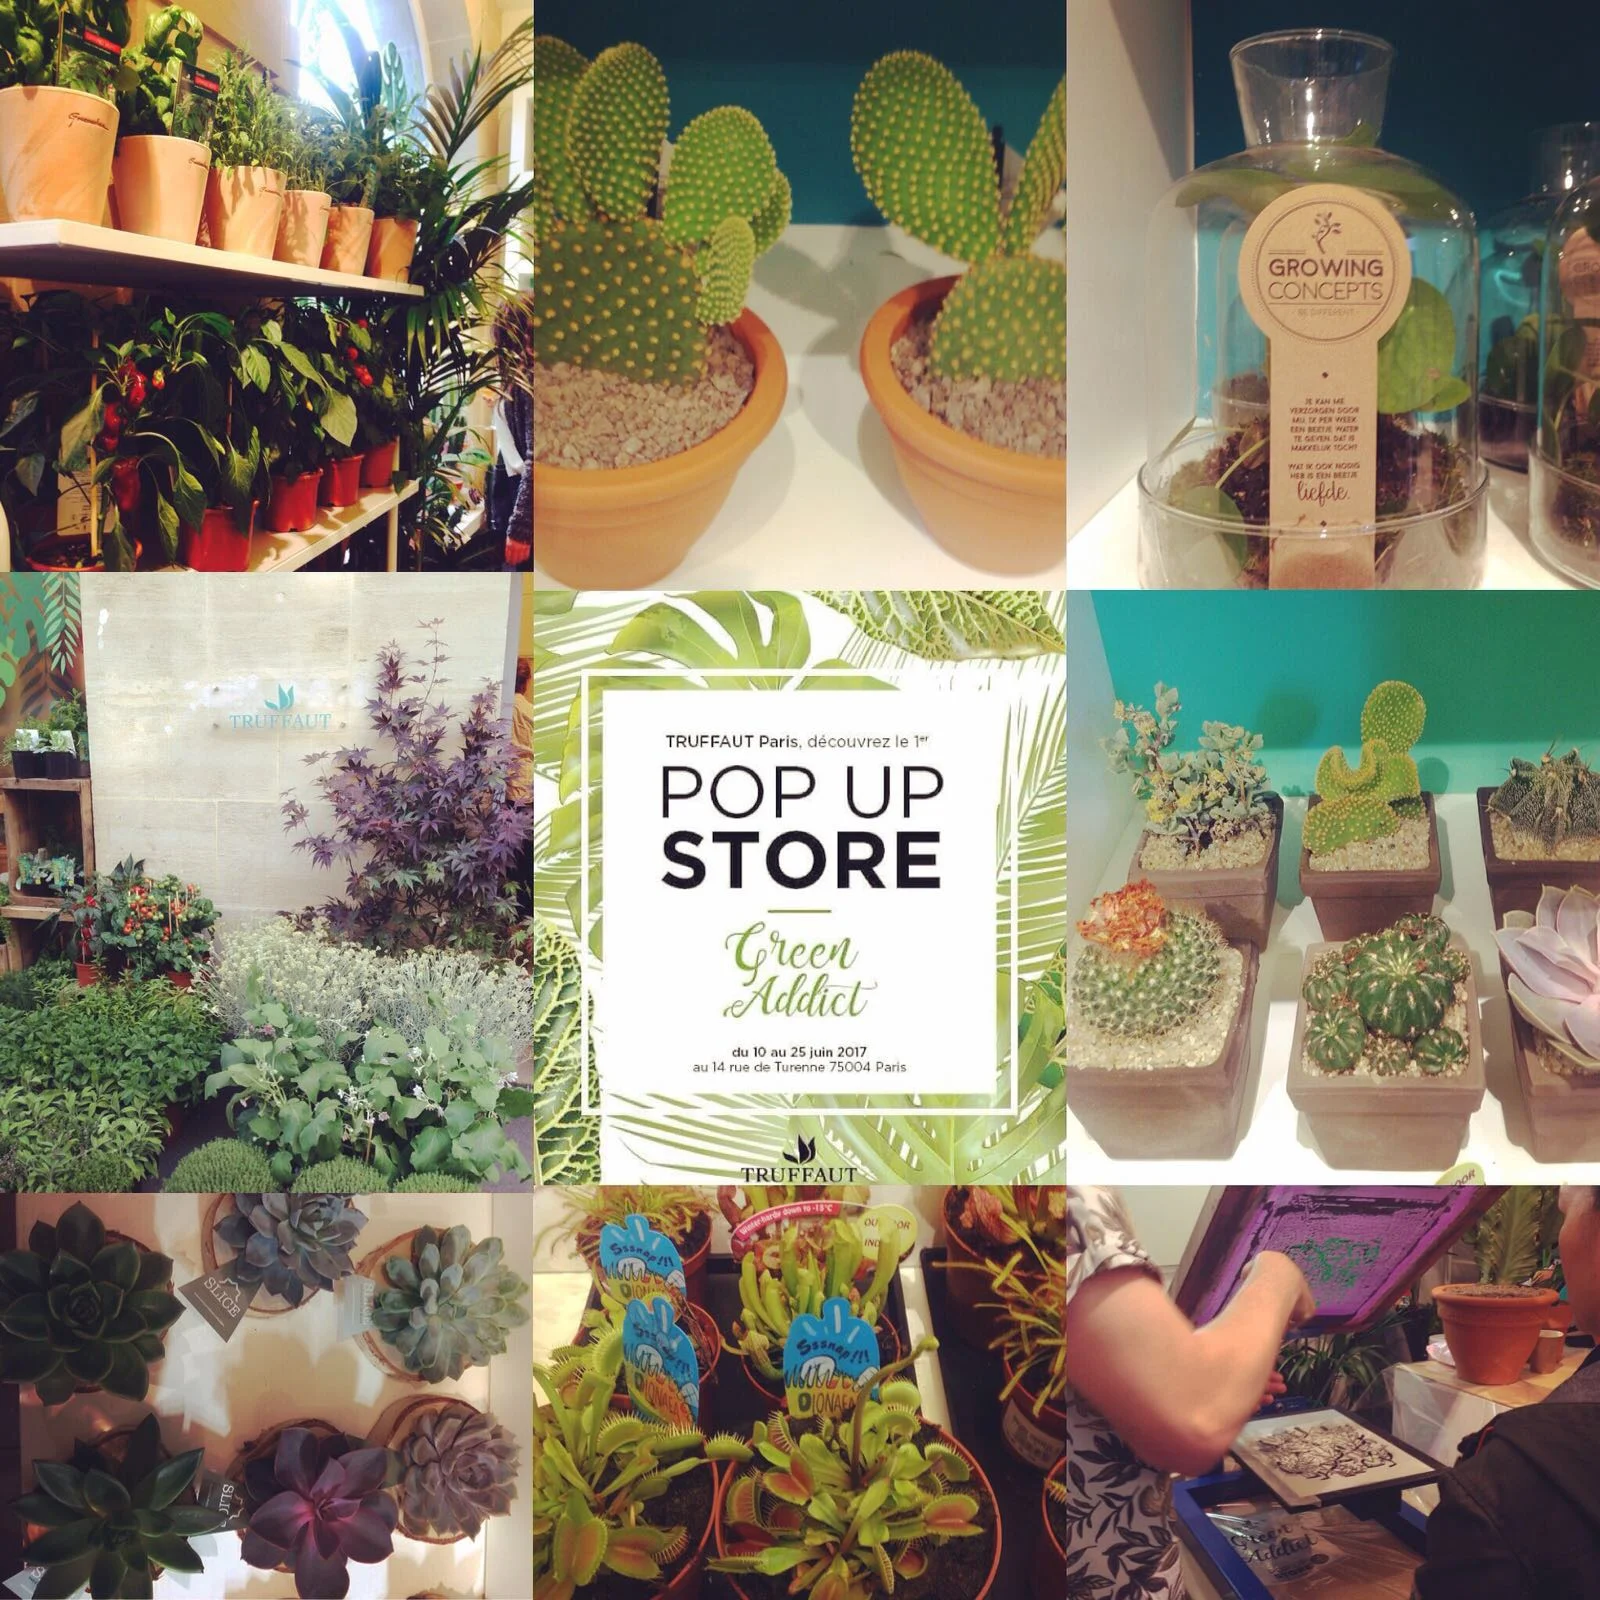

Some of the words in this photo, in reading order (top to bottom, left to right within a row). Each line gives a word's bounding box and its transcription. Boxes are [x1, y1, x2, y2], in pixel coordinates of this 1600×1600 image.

[1268, 258, 1384, 277] GROWING
[1268, 281, 1384, 300] CONCEPTS
[1333, 471, 1358, 479] BEETJE
[1335, 462, 1360, 470] NODIG
[1297, 480, 1351, 508] liefde.
[229, 713, 333, 730] TRUFFAUT
[665, 734, 755, 748] TRUFFAUT
[758, 734, 803, 751] Paris,
[807, 734, 892, 748] découvrez
[895, 734, 909, 748] le
[662, 765, 816, 819] POP
[846, 765, 944, 819] UP
[661, 830, 941, 889] STORE
[725, 921, 860, 987] Green
[723, 972, 878, 1019] Addict
[732, 1046, 749, 1058] du
[753, 1046, 767, 1058] 10
[770, 1048, 787, 1058] au
[790, 1046, 806, 1058] 25
[809, 1046, 833, 1060] juin
[837, 1046, 868, 1058] 2017
[692, 1063, 709, 1072] au
[712, 1061, 726, 1072] 14
[729, 1063, 750, 1072] rue
[754, 1061, 771, 1072] de
[774, 1061, 826, 1072] Turenne
[829, 1061, 871, 1072] 75004
[875, 1061, 907, 1073] Paris
[740, 1167, 858, 1183] TRUFFAUT
[783, 1206, 802, 1216] down
[803, 1204, 811, 1212] to
[864, 1217, 911, 1231] OUOR
[204, 1276, 241, 1318] SLICE
[1230, 1526, 1292, 1550] Green
